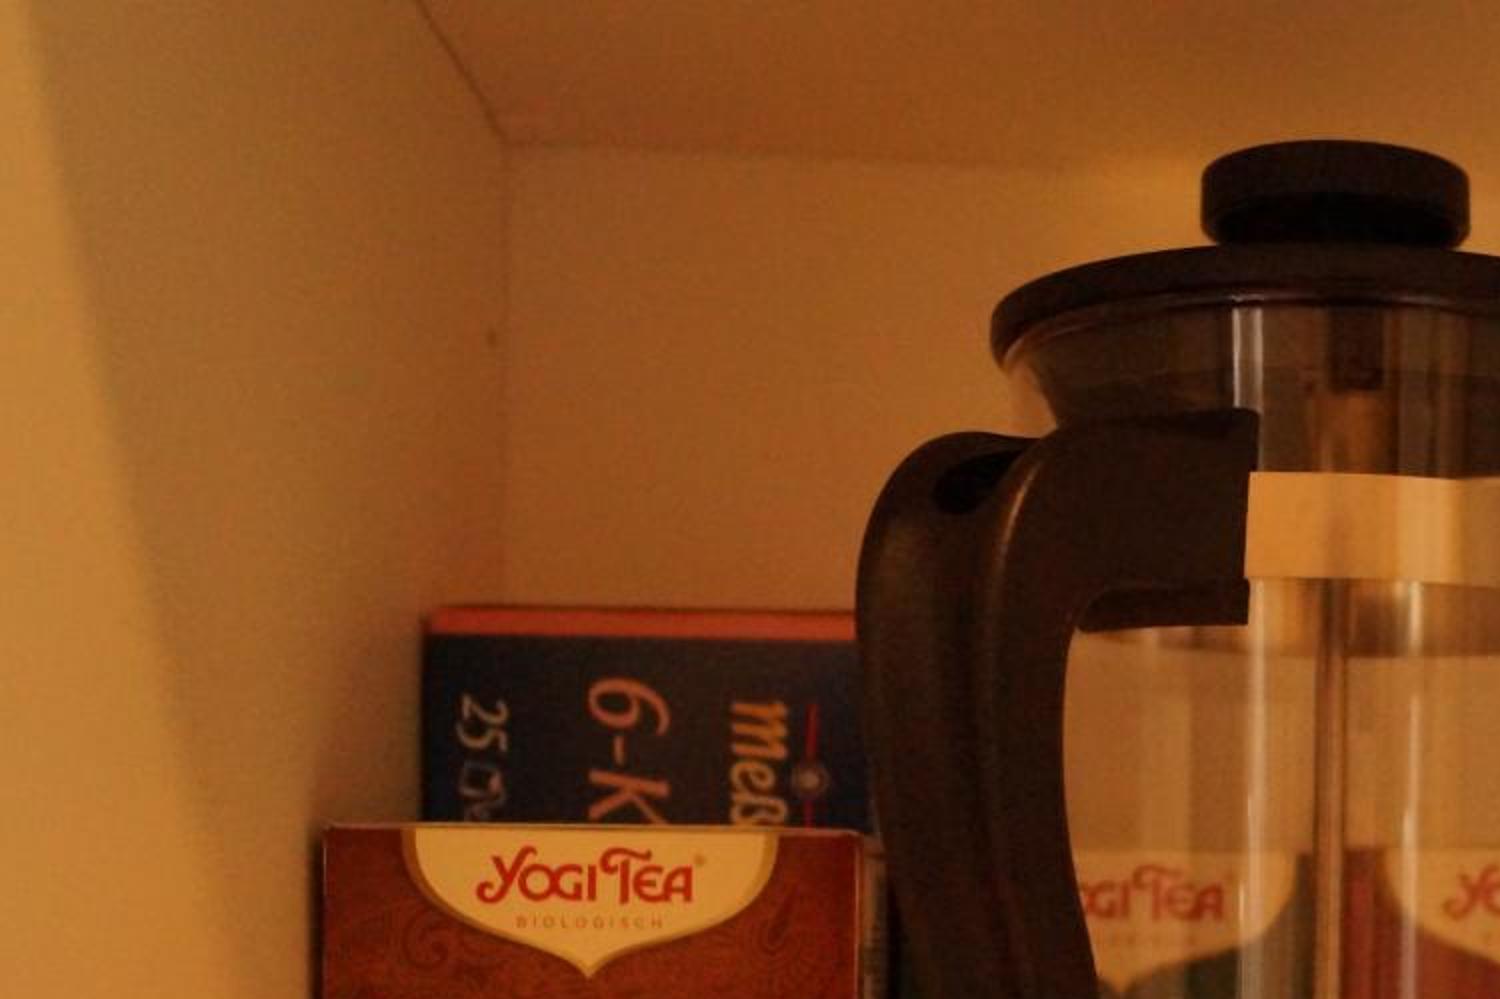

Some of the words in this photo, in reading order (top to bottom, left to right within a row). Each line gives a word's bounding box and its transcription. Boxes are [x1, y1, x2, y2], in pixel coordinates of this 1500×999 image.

[456, 693, 510, 752] 25
[477, 845, 597, 903] YOGI
[600, 847, 694, 904] TEA
[515, 913, 664, 929] BIOLOGISCH
